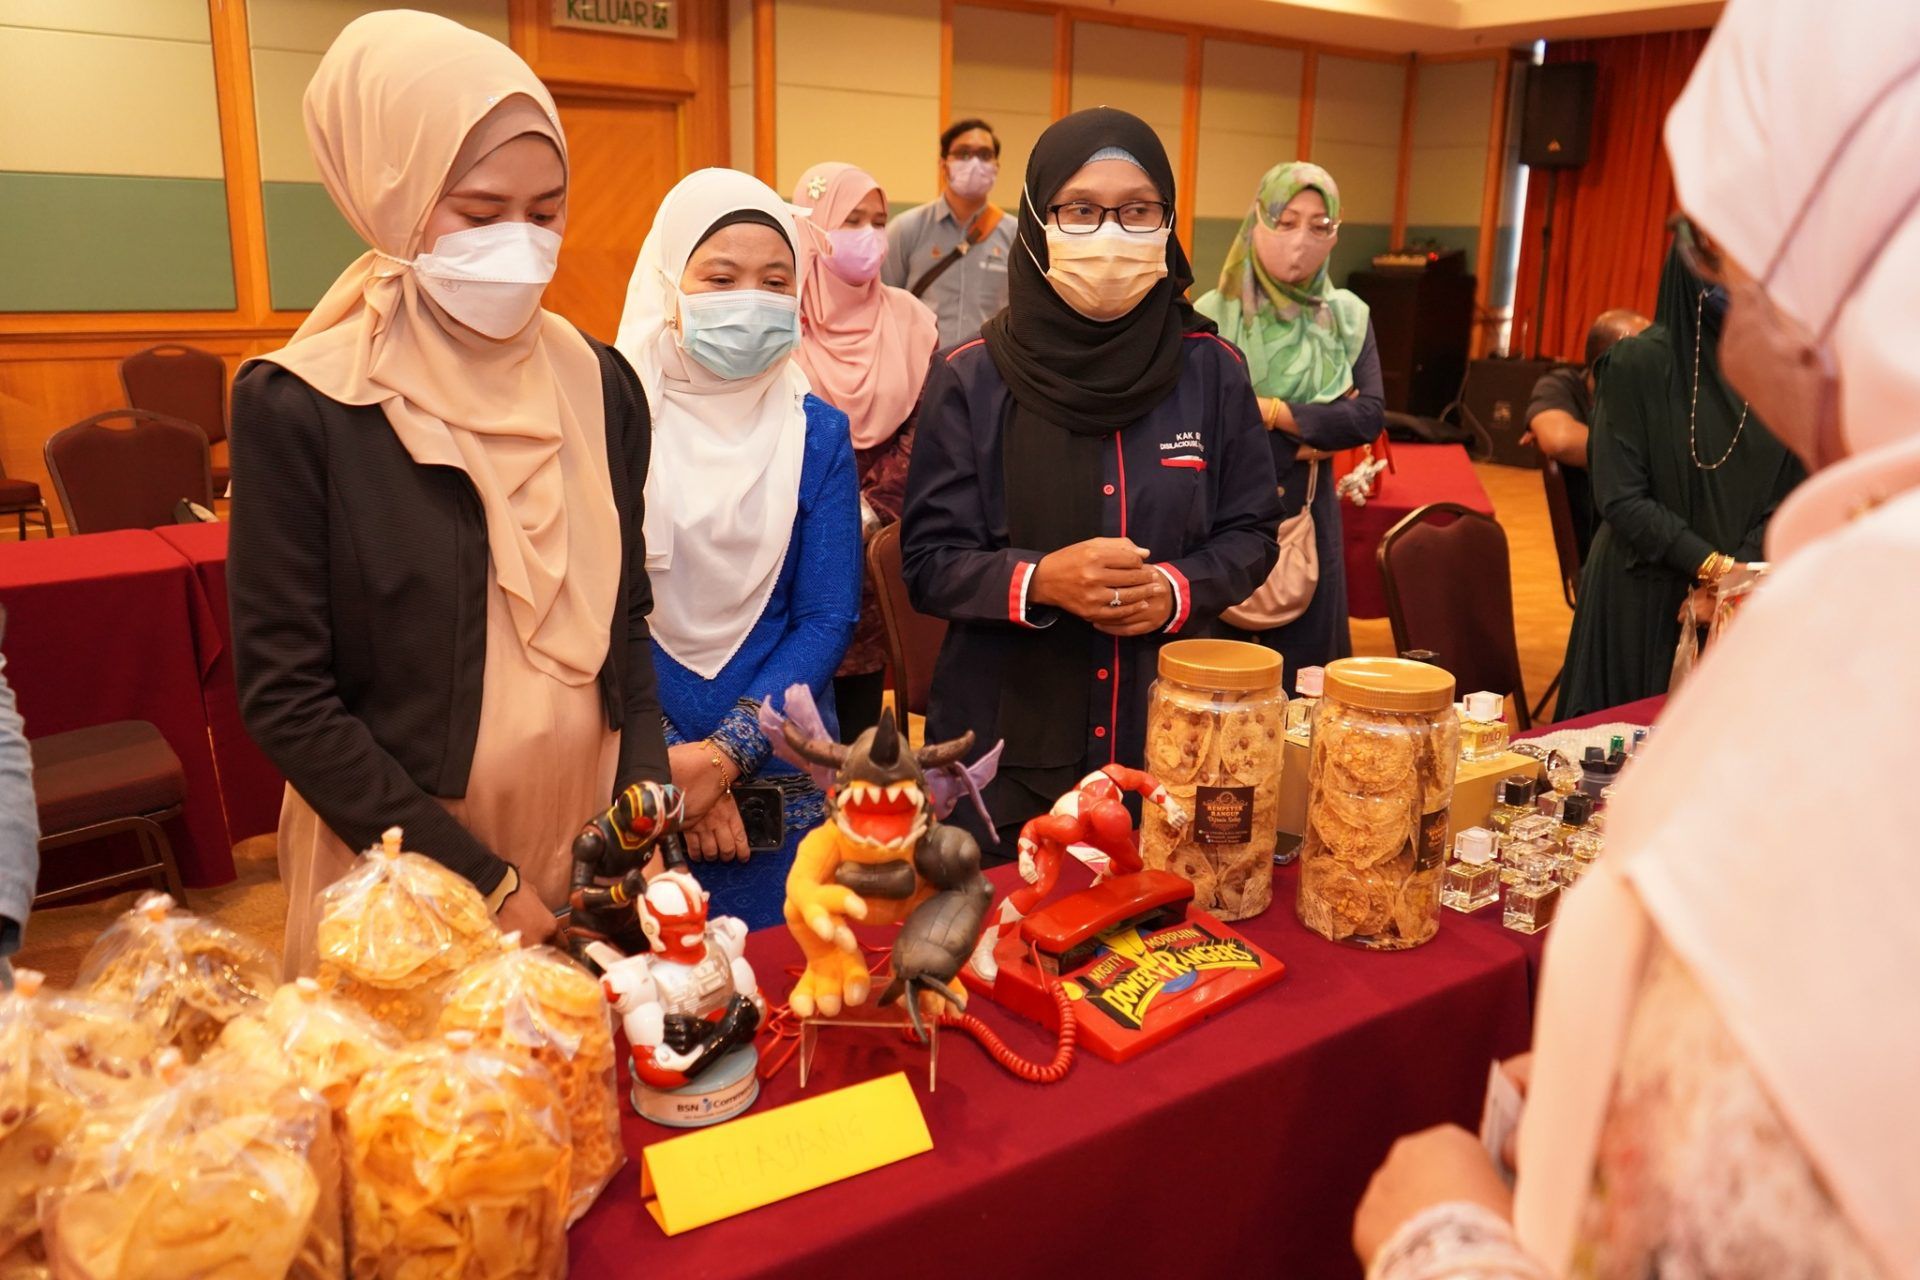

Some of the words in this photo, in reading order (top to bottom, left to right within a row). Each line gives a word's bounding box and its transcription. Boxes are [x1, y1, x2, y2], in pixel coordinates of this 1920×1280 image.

[567, 0, 648, 27] KELUAR
[1176, 431, 1194, 440] KAK
[1146, 928, 1201, 950] MORPHIN
[1088, 954, 1126, 984] MIGHTY
[1101, 964, 1157, 1023] POWER
[1157, 943, 1253, 977] RANGERS
[677, 1103, 699, 1112] BSN
